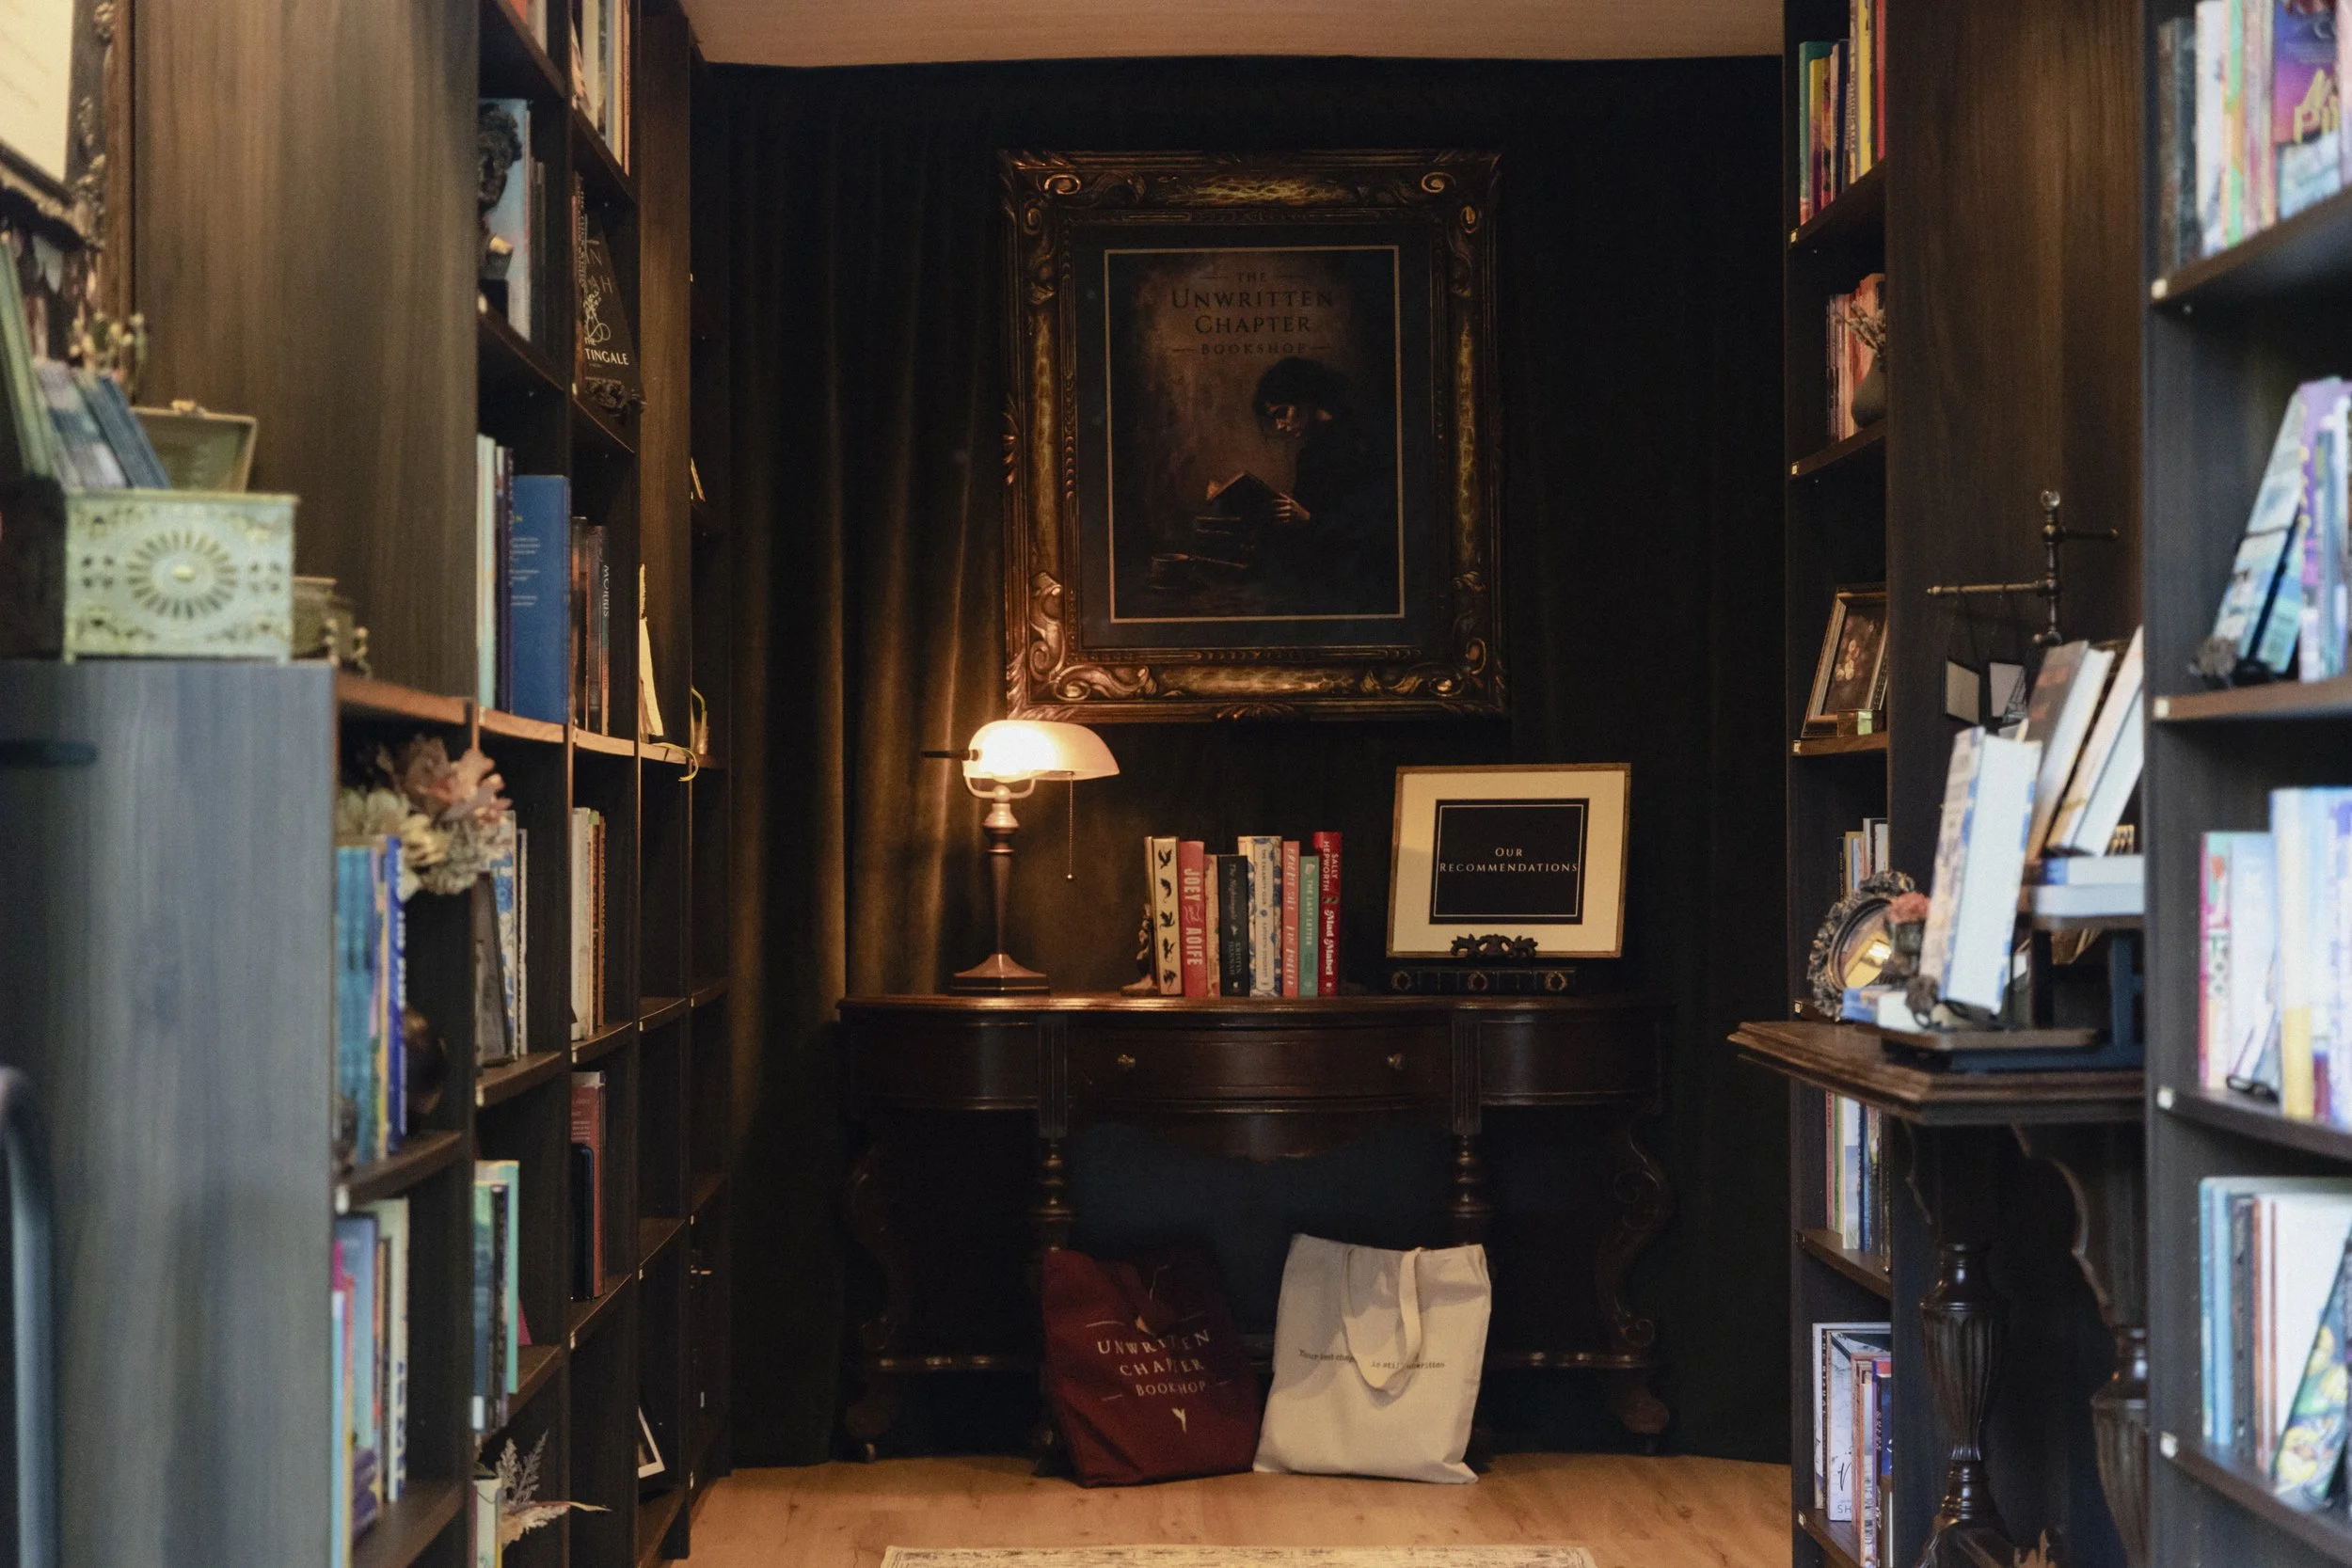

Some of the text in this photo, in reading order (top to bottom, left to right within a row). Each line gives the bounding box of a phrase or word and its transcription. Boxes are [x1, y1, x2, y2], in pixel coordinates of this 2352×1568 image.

[1236, 272, 1267, 282] THE
[1171, 288, 1333, 309] UNWRITTEN
[1194, 315, 1311, 334] CHAPTER
[1200, 342, 1307, 356] BOOKSHOP
[1494, 847, 1523, 858] OUR
[1322, 840, 1331, 893] HEPWORTH
[1438, 862, 1579, 873] RECOMMENDATIONS
[1183, 867, 1201, 901] JOEY
[1306, 879, 1314, 895] THE
[1185, 927, 1203, 966] AOIFE
[1323, 909, 1335, 976] Mad Mabel
